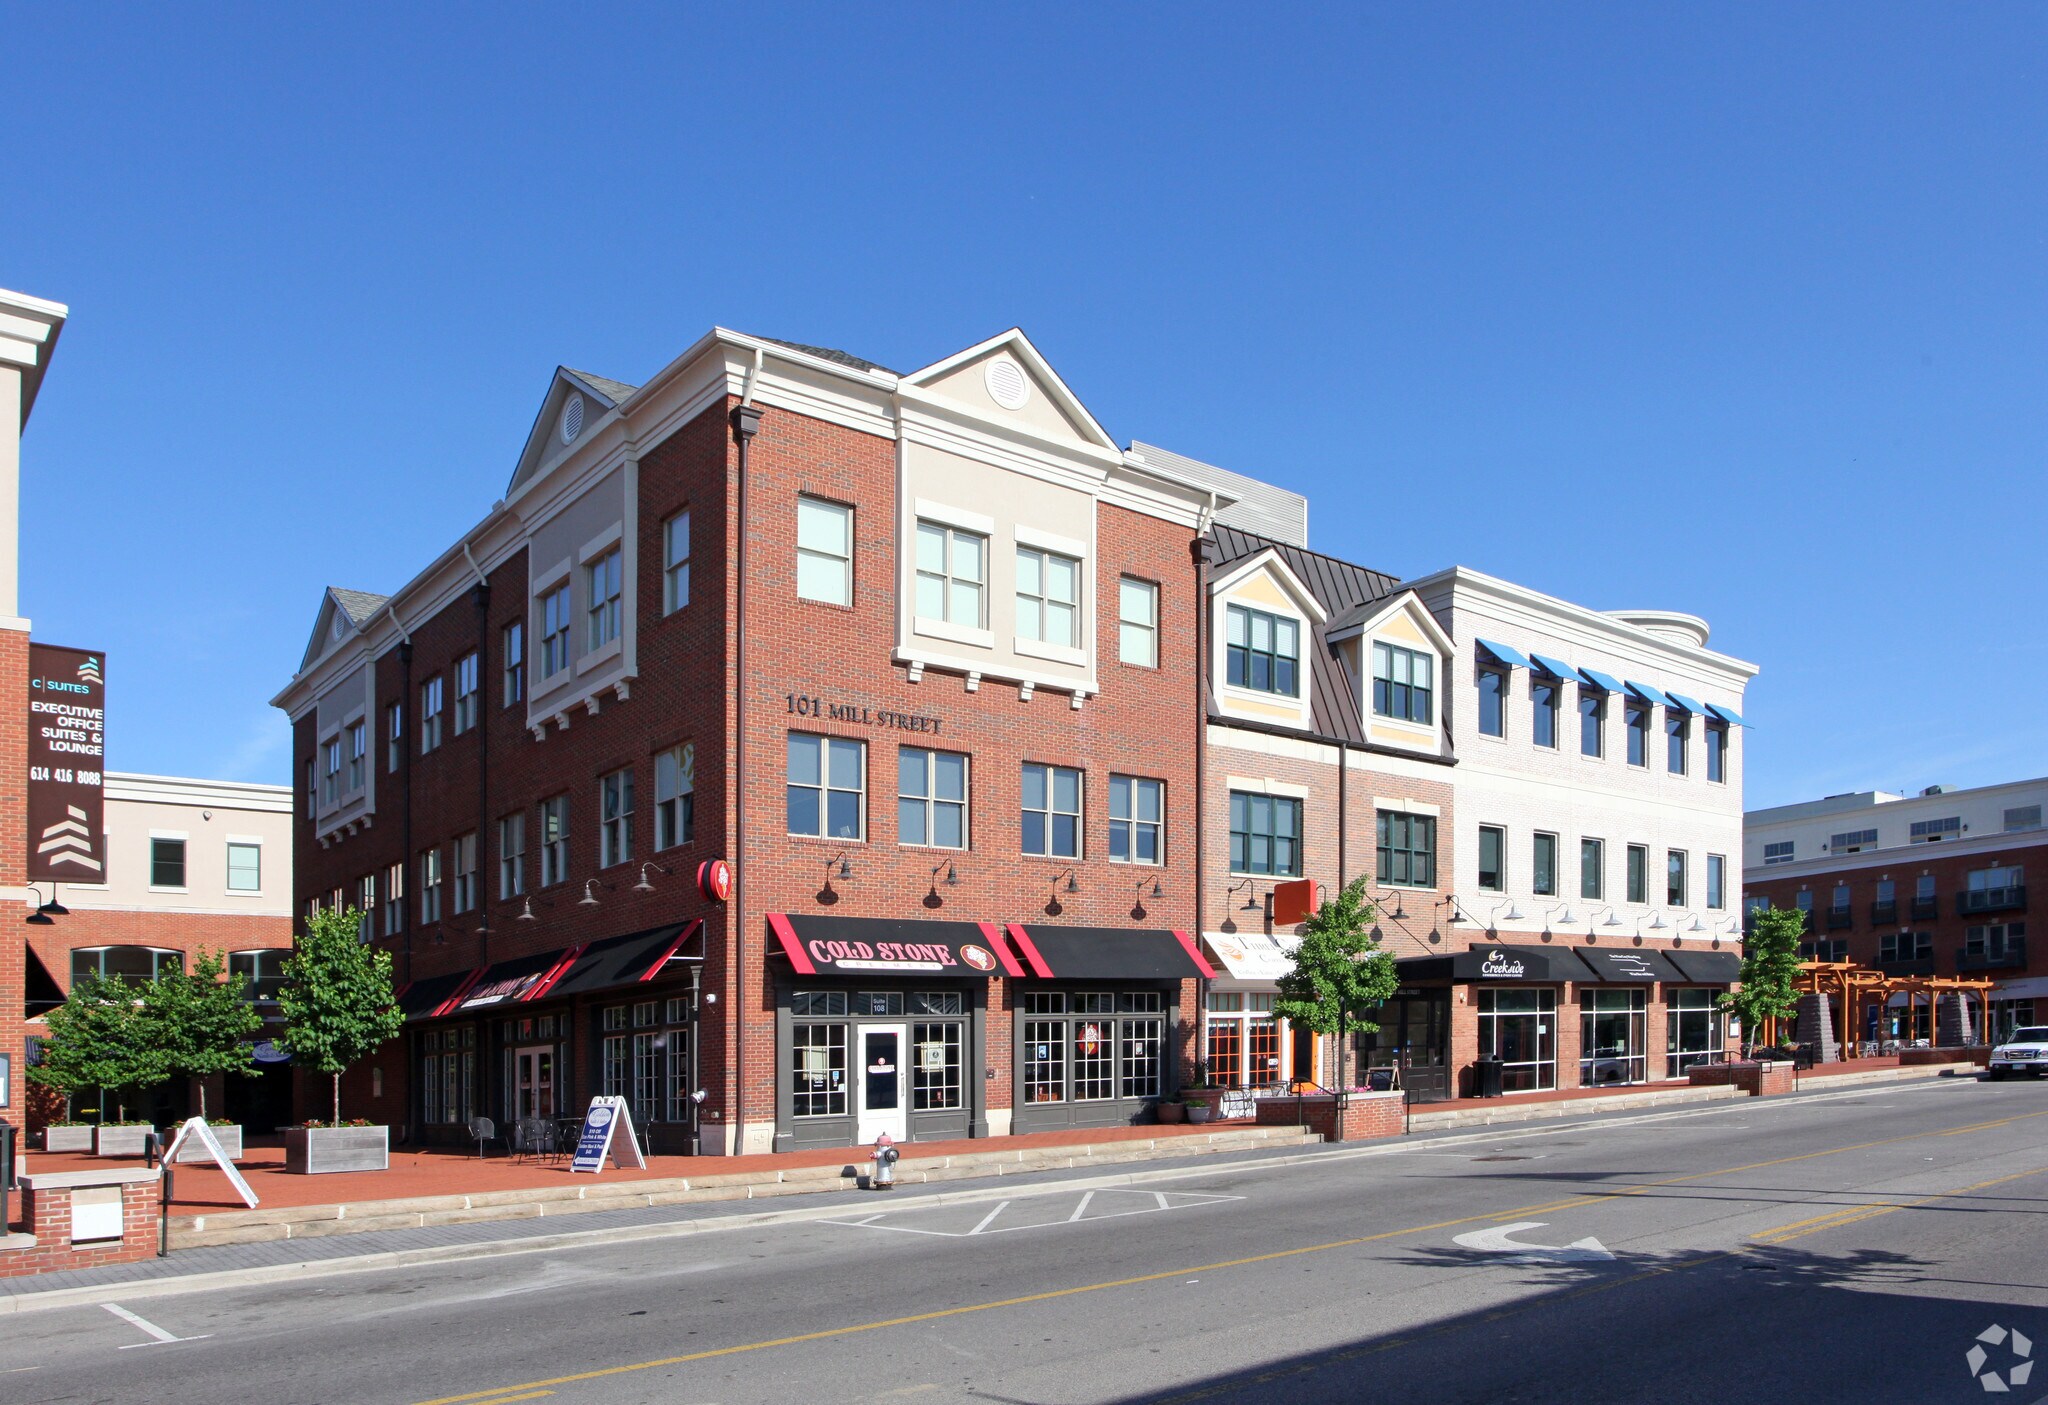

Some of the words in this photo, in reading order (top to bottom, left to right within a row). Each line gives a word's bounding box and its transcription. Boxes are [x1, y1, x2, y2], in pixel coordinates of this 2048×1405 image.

[32, 679, 41, 688] C
[47, 680, 90, 694] SUITES
[31, 701, 103, 719] EXECUTIVE
[786, 692, 821, 718] 101
[829, 703, 874, 725] MILL
[877, 710, 943, 734] STREET
[57, 716, 103, 731] OFFICE
[41, 727, 86, 742] SUITES
[91, 732, 102, 743] &
[49, 740, 103, 756] LOUNGE
[30, 766, 50, 781] 614
[54, 768, 73, 783] 416
[77, 770, 101, 785] 8088
[809, 939, 874, 963] COLD
[876, 942, 958, 966] STONE
[1482, 960, 1524, 974] Creekside
[873, 1004, 886, 1012] 108
